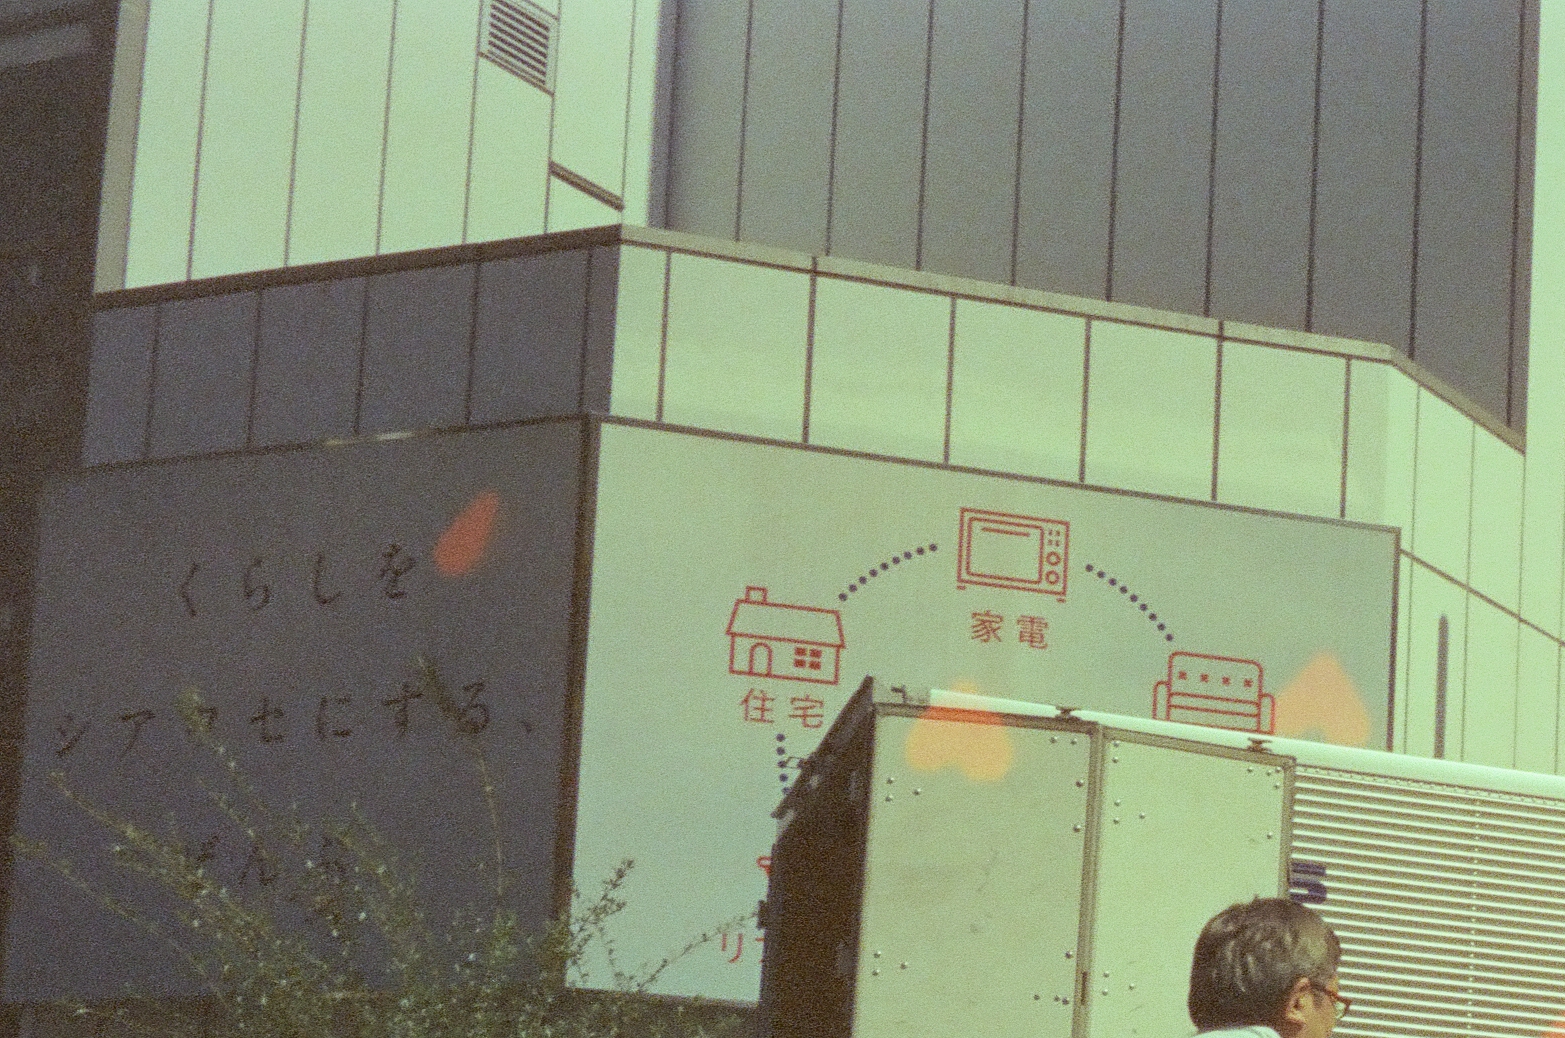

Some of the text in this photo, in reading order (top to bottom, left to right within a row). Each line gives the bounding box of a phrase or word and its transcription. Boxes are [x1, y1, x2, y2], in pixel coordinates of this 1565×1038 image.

[178, 543, 416, 618] くらしを
[969, 610, 1049, 651] 家電
[740, 688, 825, 730] 住宅
[720, 932, 766, 964] リ
